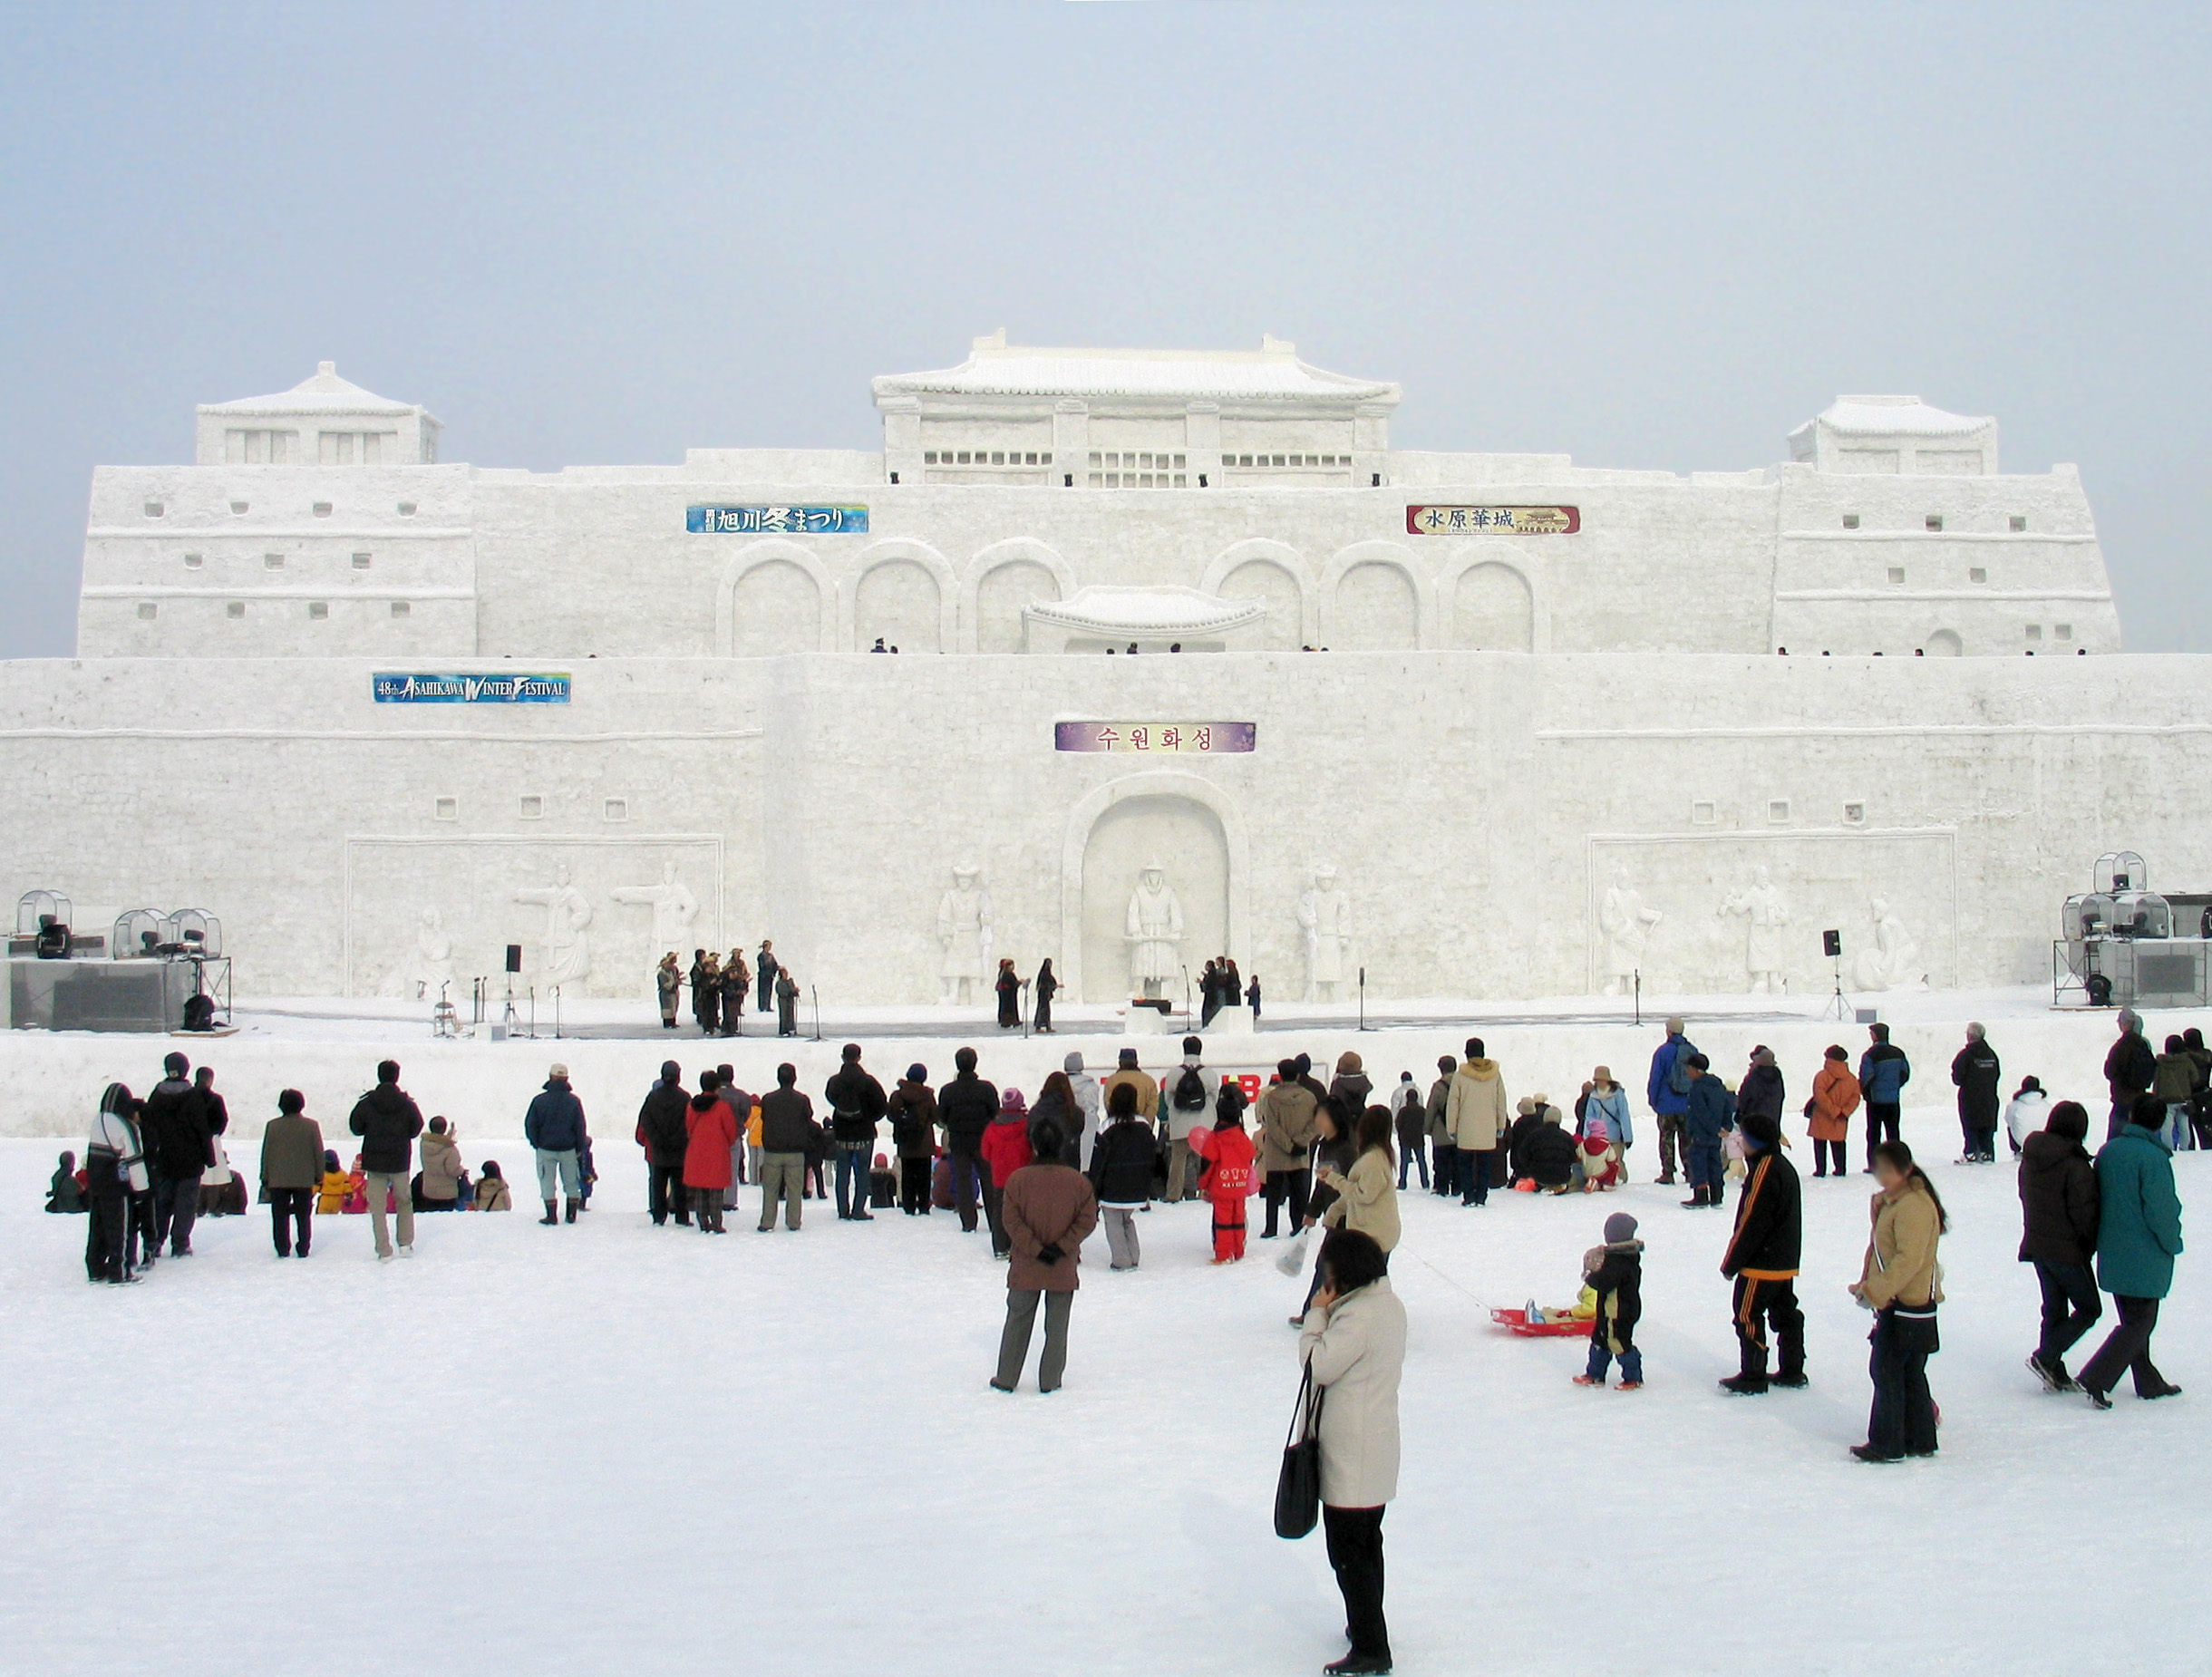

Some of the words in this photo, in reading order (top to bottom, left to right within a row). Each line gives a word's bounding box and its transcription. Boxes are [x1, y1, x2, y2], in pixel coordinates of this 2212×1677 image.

[717, 508, 843, 533] 旭川冬まつり
[1425, 509, 1516, 528] 水原華城
[378, 682, 399, 695] 48th
[399, 676, 464, 700] ASAHIKAWA
[465, 676, 512, 701] WINTER
[512, 676, 566, 701] FESTIVAL
[1098, 727, 1210, 751] 수원화성
